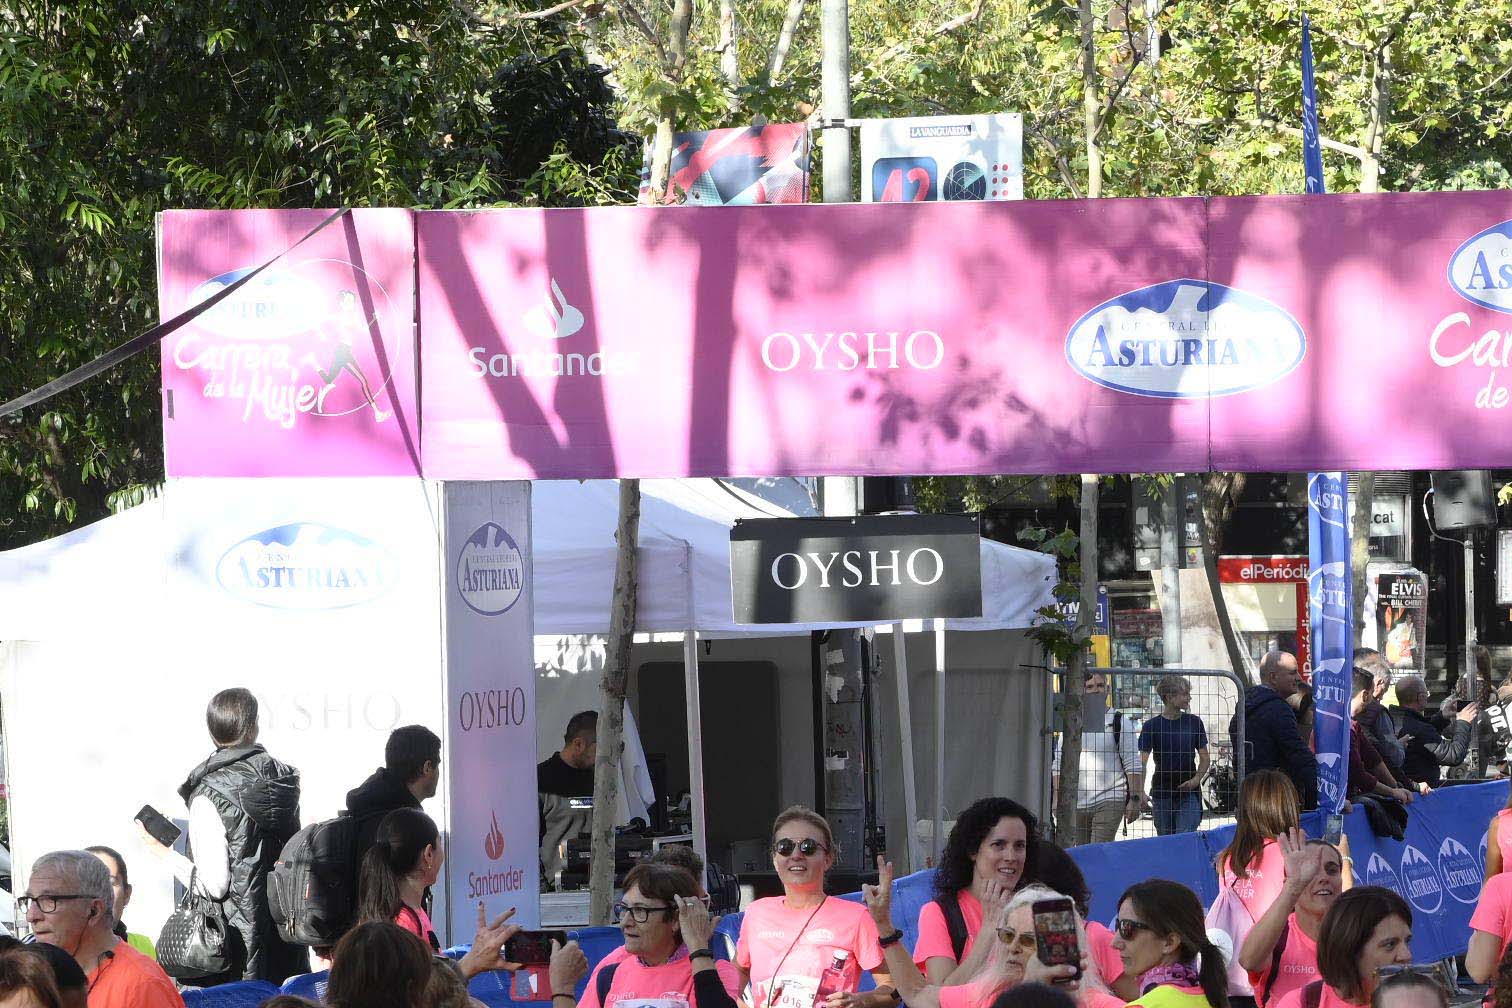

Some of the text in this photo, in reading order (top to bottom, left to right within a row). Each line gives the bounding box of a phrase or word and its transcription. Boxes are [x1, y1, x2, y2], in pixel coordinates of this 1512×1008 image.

[910, 124, 971, 137] LA VANGUARDIA
[467, 346, 642, 378] Santander
[760, 330, 945, 373] OYSHO
[242, 364, 337, 429] Mujer
[1474, 376, 1511, 410] de
[462, 557, 521, 593] ASTURIANA
[770, 546, 945, 592] OYSHO
[1391, 582, 1422, 596] ELVIS
[459, 686, 526, 732] OYSHO
[468, 867, 524, 900] Santander
[1284, 964, 1315, 974] OYSHO
